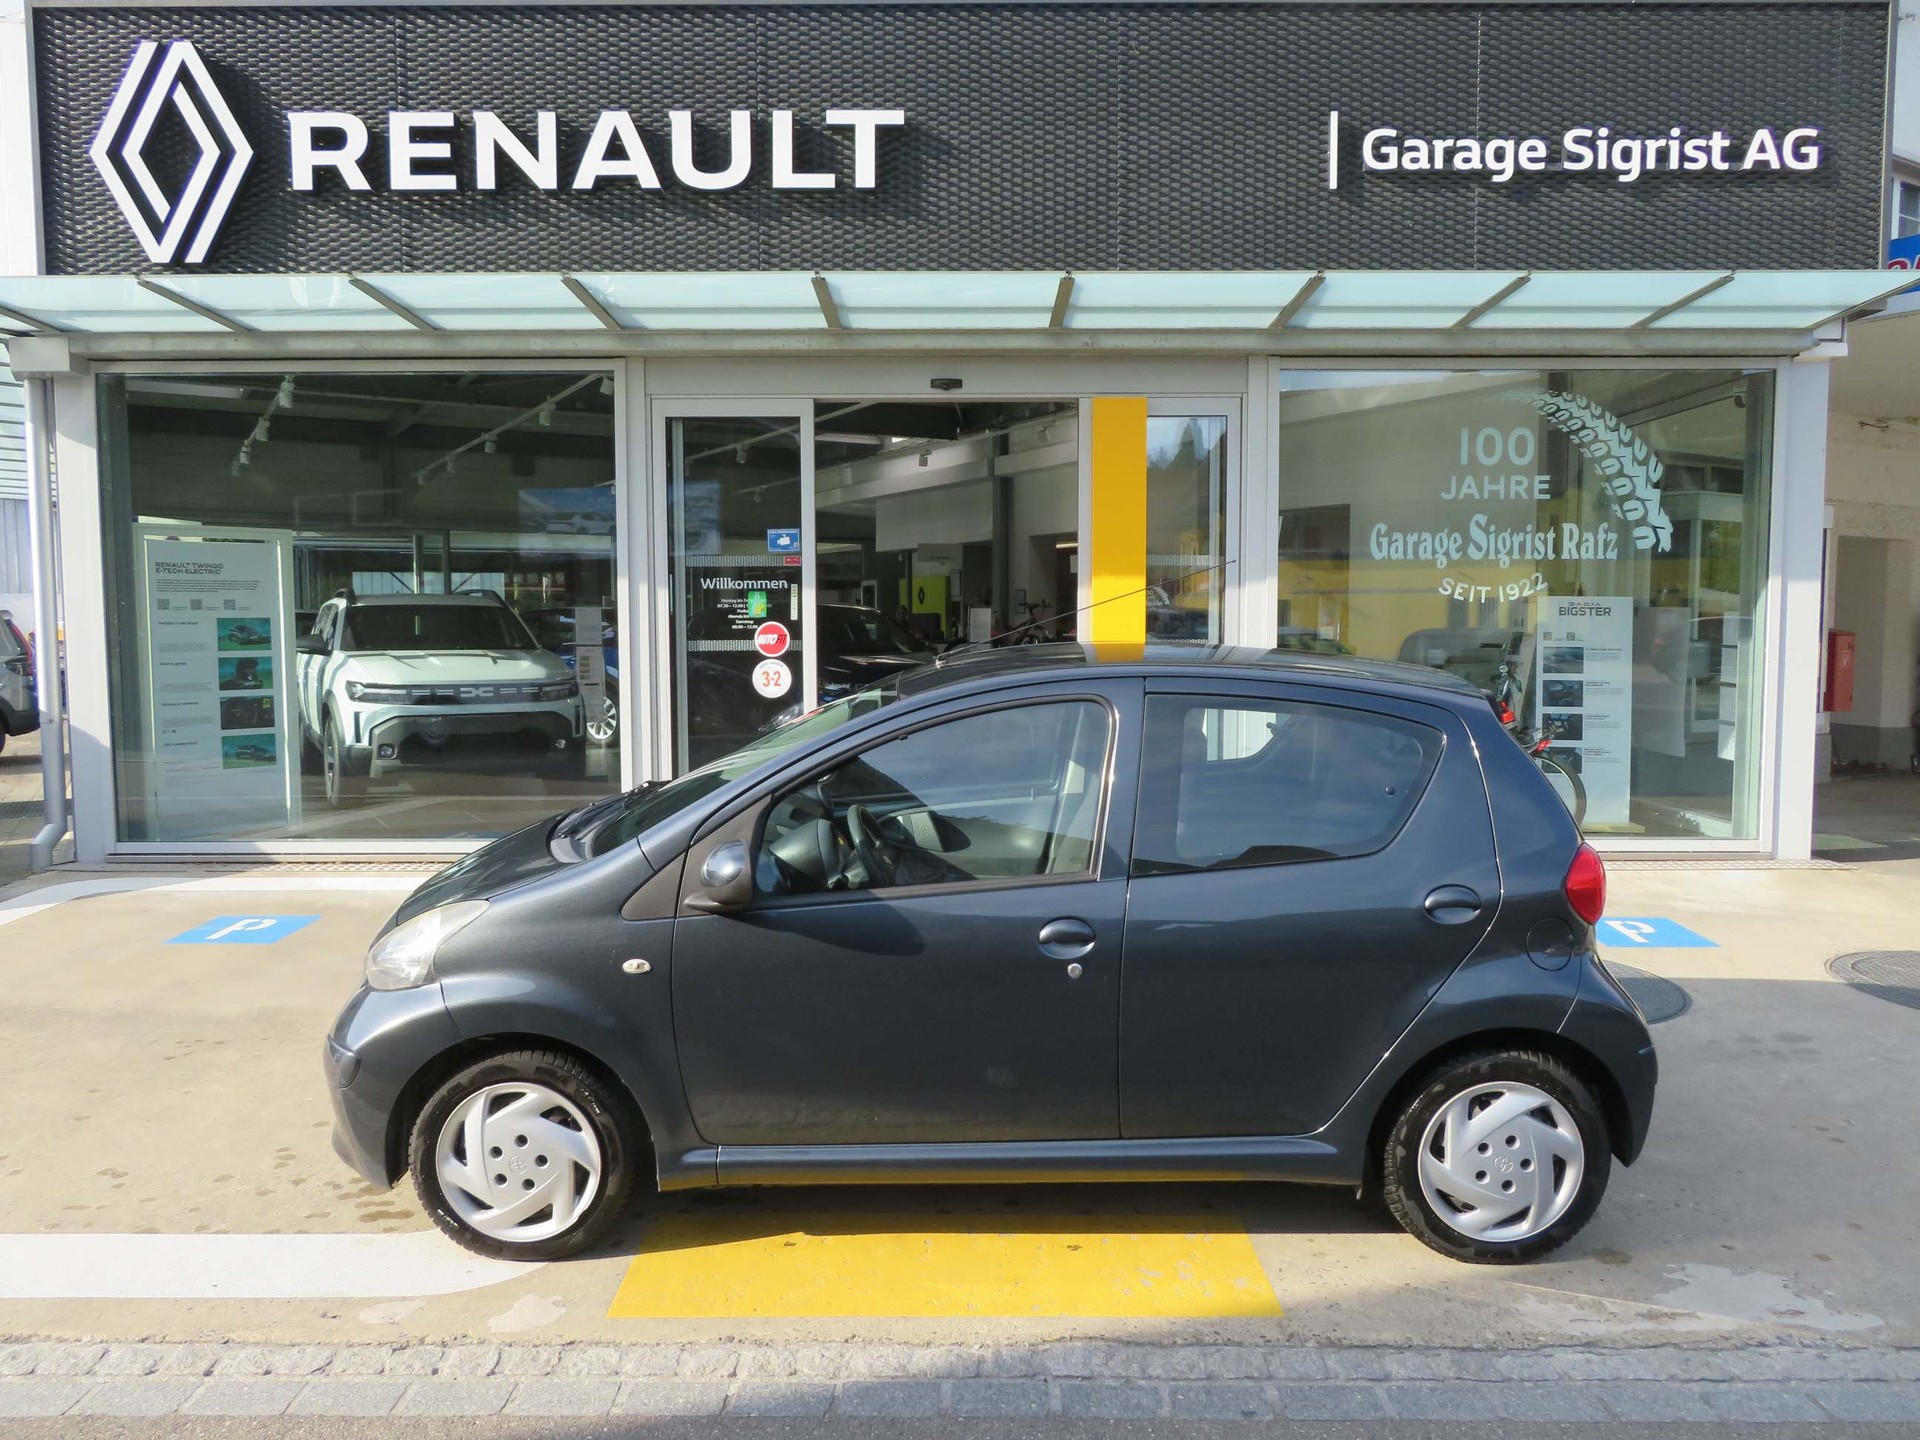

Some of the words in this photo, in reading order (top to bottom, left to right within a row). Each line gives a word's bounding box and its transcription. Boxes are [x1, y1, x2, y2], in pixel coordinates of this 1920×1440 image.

[288, 109, 906, 192] RENAULT
[1362, 128, 1547, 182] Garage
[1562, 127, 1729, 182] Sigrist
[1741, 128, 1820, 171] AG
[1460, 426, 1536, 466] 100
[1440, 475, 1551, 500] JAHRE
[1370, 522, 1463, 570] Garage
[1467, 513, 1556, 570] Sigrist
[1561, 522, 1618, 561] Rafz
[192, 562, 224, 570] TWINGO
[700, 577, 788, 589] Willkommen
[1438, 577, 1492, 604] SEIT
[1499, 572, 1549, 603] 1922
[1559, 607, 1611, 616] BIGSTER
[204, 918, 277, 940] P
[1603, 920, 1656, 943] P
